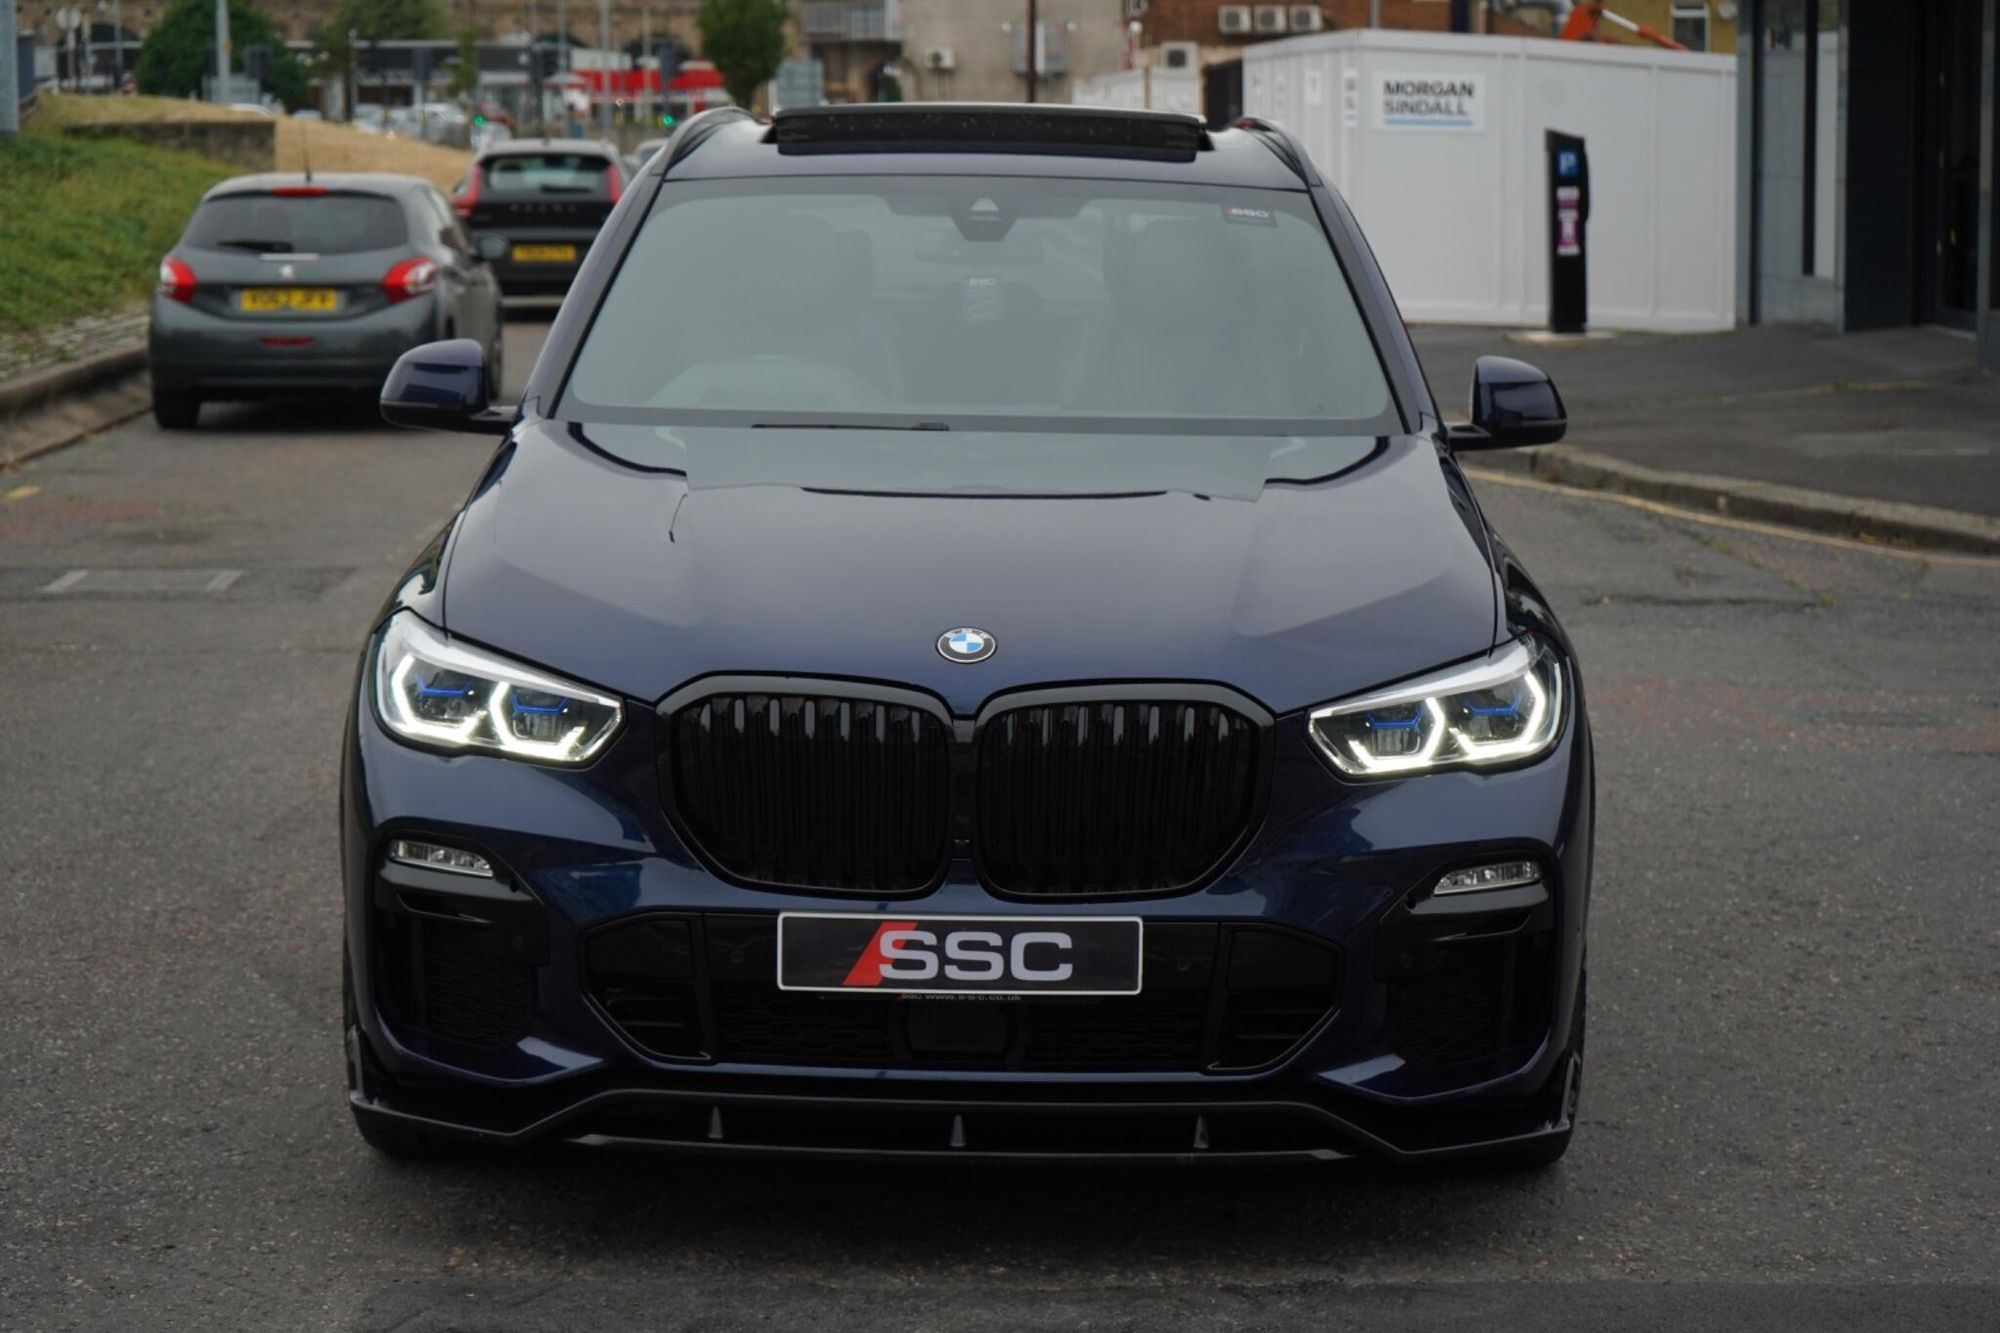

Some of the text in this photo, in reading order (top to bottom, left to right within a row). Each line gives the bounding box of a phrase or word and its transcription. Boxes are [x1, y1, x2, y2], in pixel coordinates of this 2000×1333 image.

[1383, 80, 1474, 98] MORGAN
[1383, 99, 1469, 116] SINDALL
[879, 930, 1073, 981] SSC
